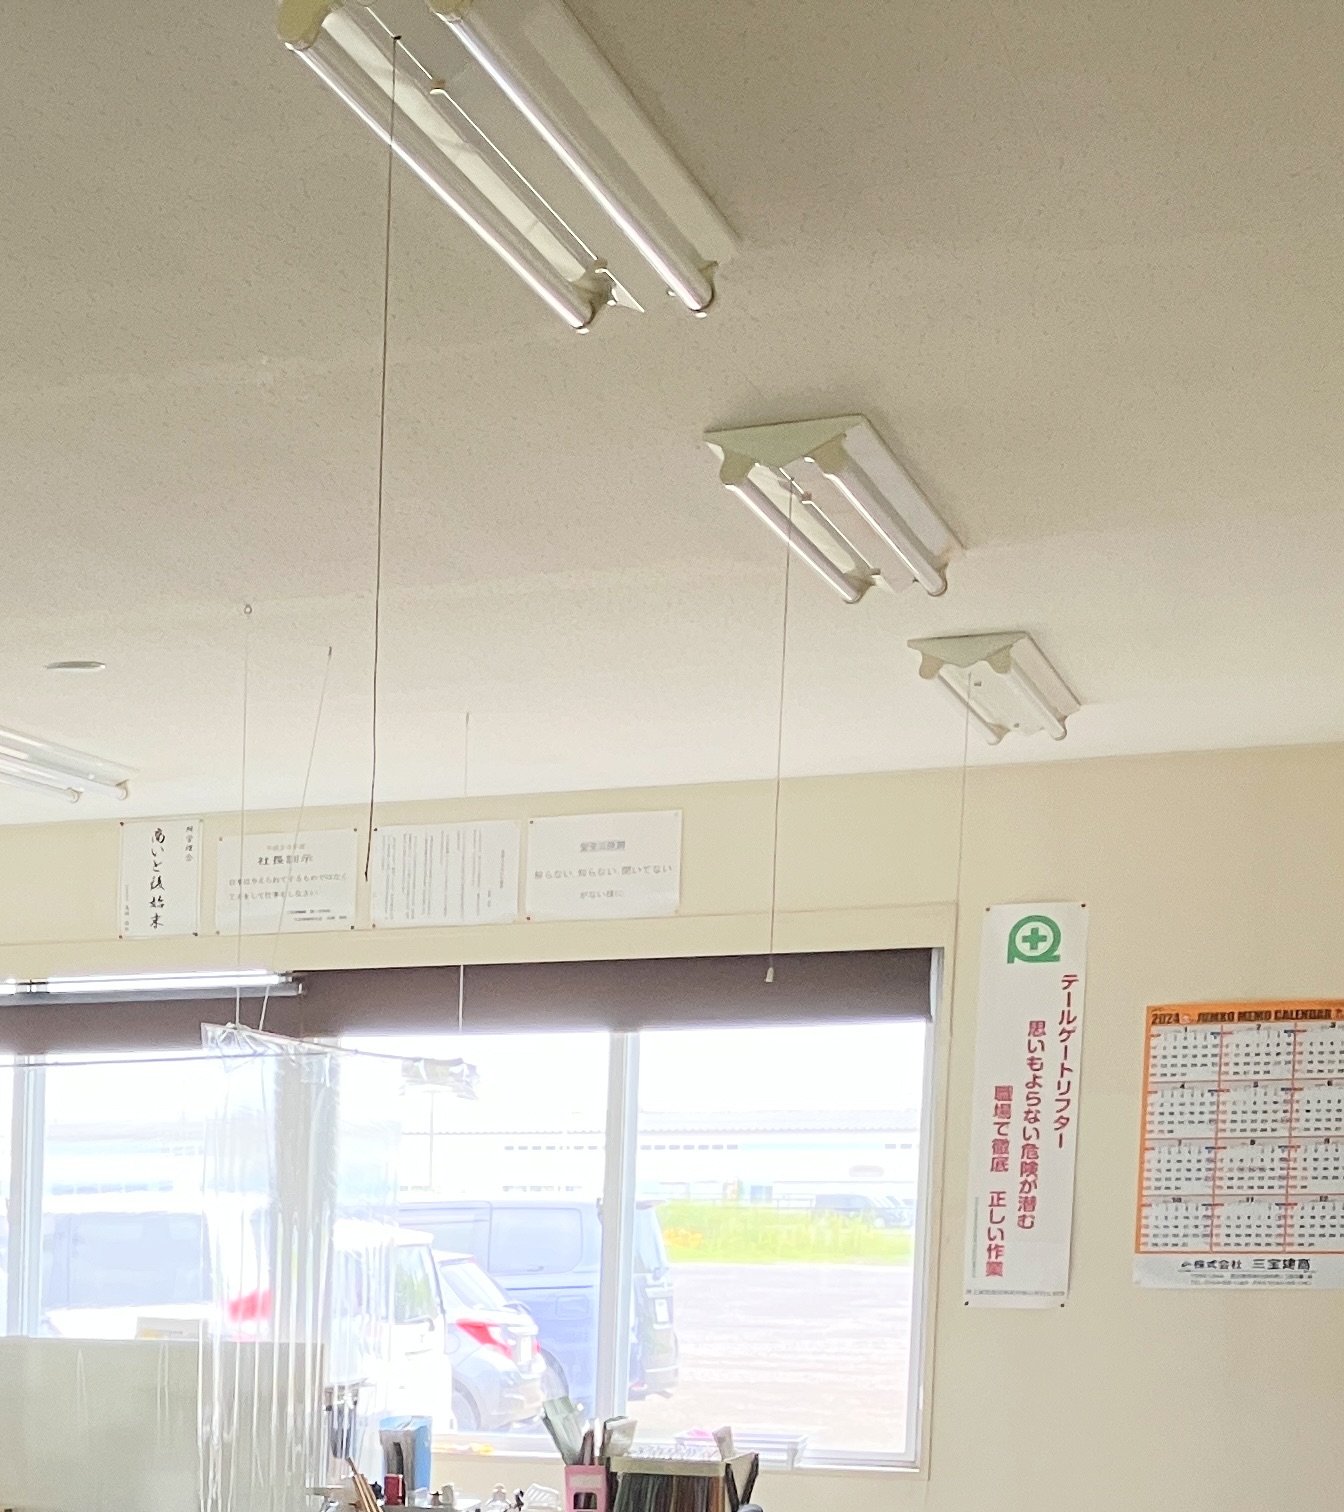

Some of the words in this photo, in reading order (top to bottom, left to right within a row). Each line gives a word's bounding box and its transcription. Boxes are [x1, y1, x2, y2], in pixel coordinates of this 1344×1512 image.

[257, 853, 314, 866] 社長訓示
[1017, 1020, 1046, 1229] 思いもよらない危険が潜む
[1053, 974, 1079, 1149] テールゲートリフター
[986, 1190, 1007, 1277] 正しい作業
